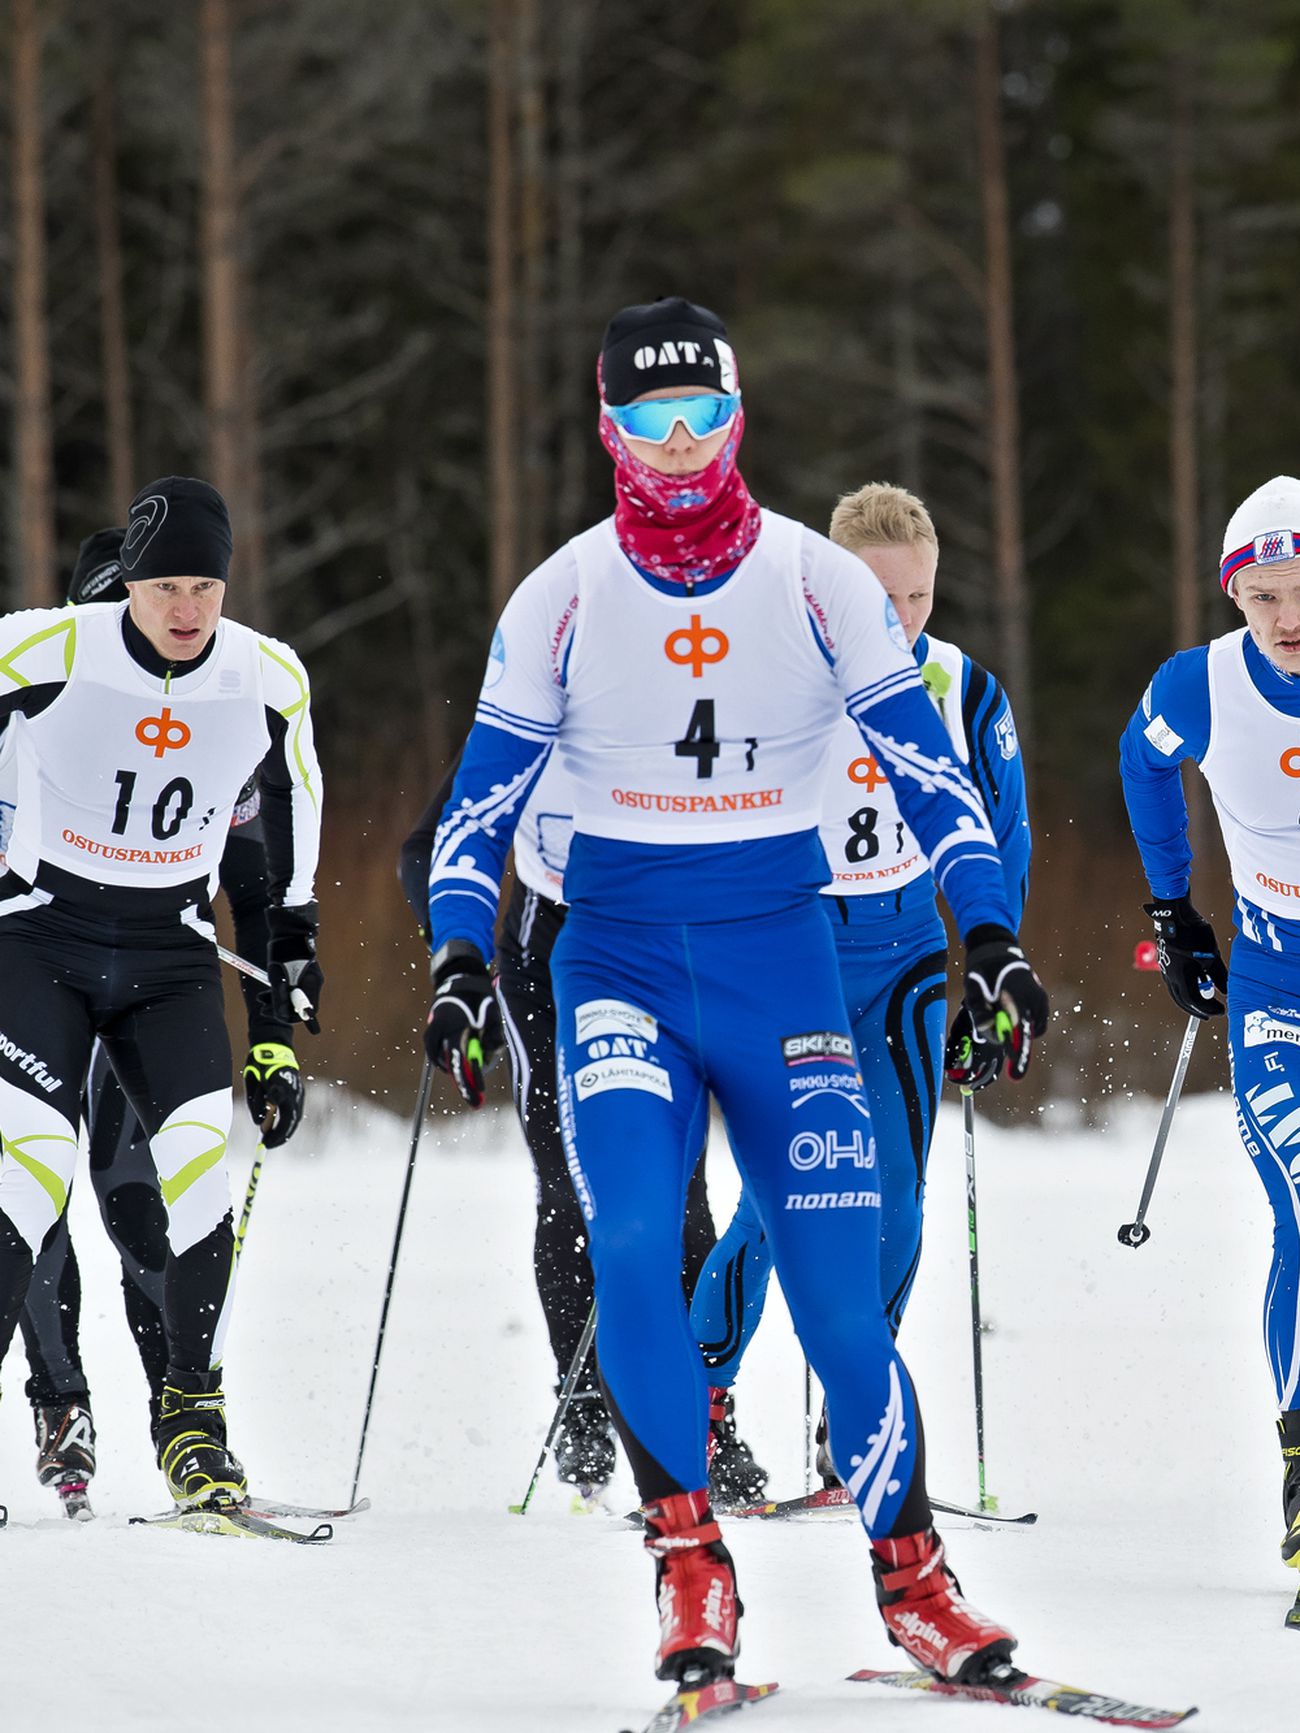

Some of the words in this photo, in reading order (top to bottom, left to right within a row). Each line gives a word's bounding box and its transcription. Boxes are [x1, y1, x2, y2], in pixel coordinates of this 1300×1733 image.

[675, 699, 720, 779] 4
[112, 770, 193, 840] 10
[612, 789, 784, 812] OSUUSPANKKI
[62, 829, 204, 863] OSUUSPANKKI
[845, 807, 879, 863] 8
[894, 1611, 949, 1650] alpina
